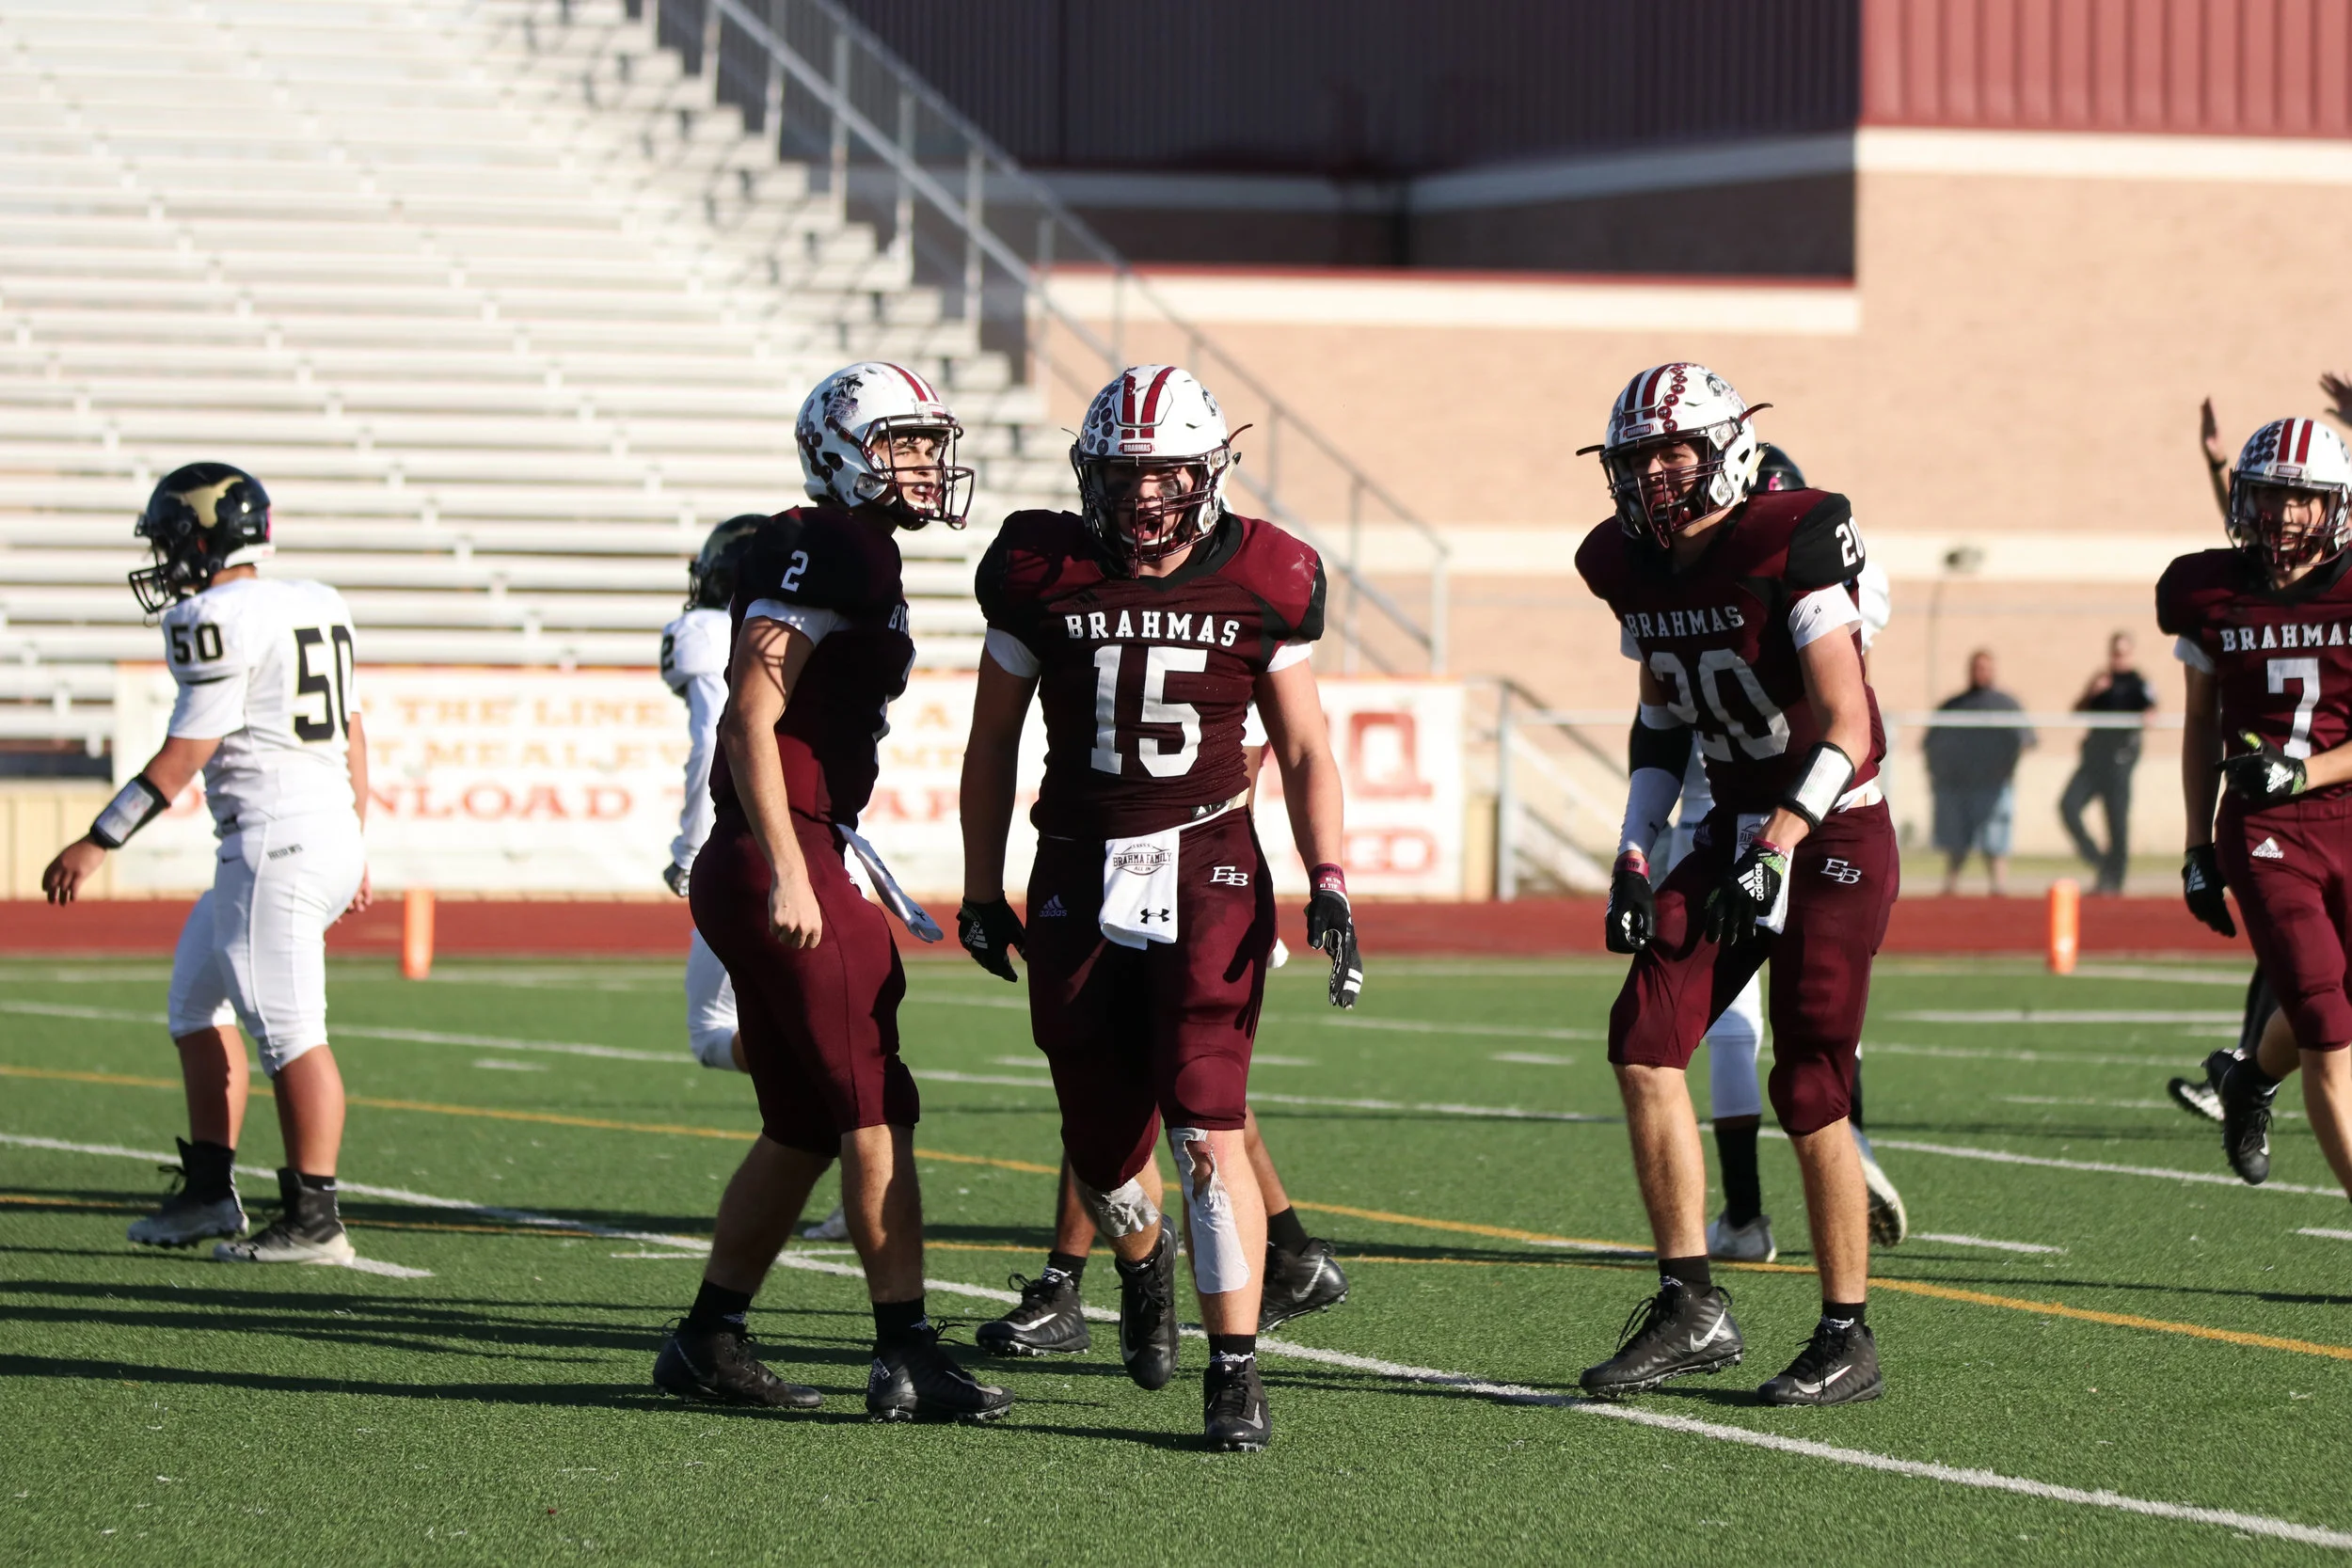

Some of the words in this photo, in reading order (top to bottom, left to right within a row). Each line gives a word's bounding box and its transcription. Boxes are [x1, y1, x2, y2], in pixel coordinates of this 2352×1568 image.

[1123, 443, 1152, 452] BRAHMAS
[781, 549, 809, 593] 2
[1065, 610, 1240, 647] BRAHMAS
[1625, 606, 1745, 639] BRAHMAS
[170, 623, 224, 665] 50
[292, 624, 354, 743] 50
[1090, 643, 1208, 778] 15
[1649, 647, 1791, 763] 20
[2266, 657, 2321, 760] 7
[2265, 769, 2295, 794] adidas
[367, 782, 636, 822] NLOAD
[1113, 853, 1145, 867] BRAHMA
[1146, 852, 1172, 864] FAMILY
[1820, 858, 1862, 884] EB
[2251, 848, 2285, 860] adidas
[1210, 865, 1249, 887] EB
[1754, 863, 1765, 901] adidas
[1039, 908, 1068, 918] adidas
[964, 920, 981, 944] adidas
